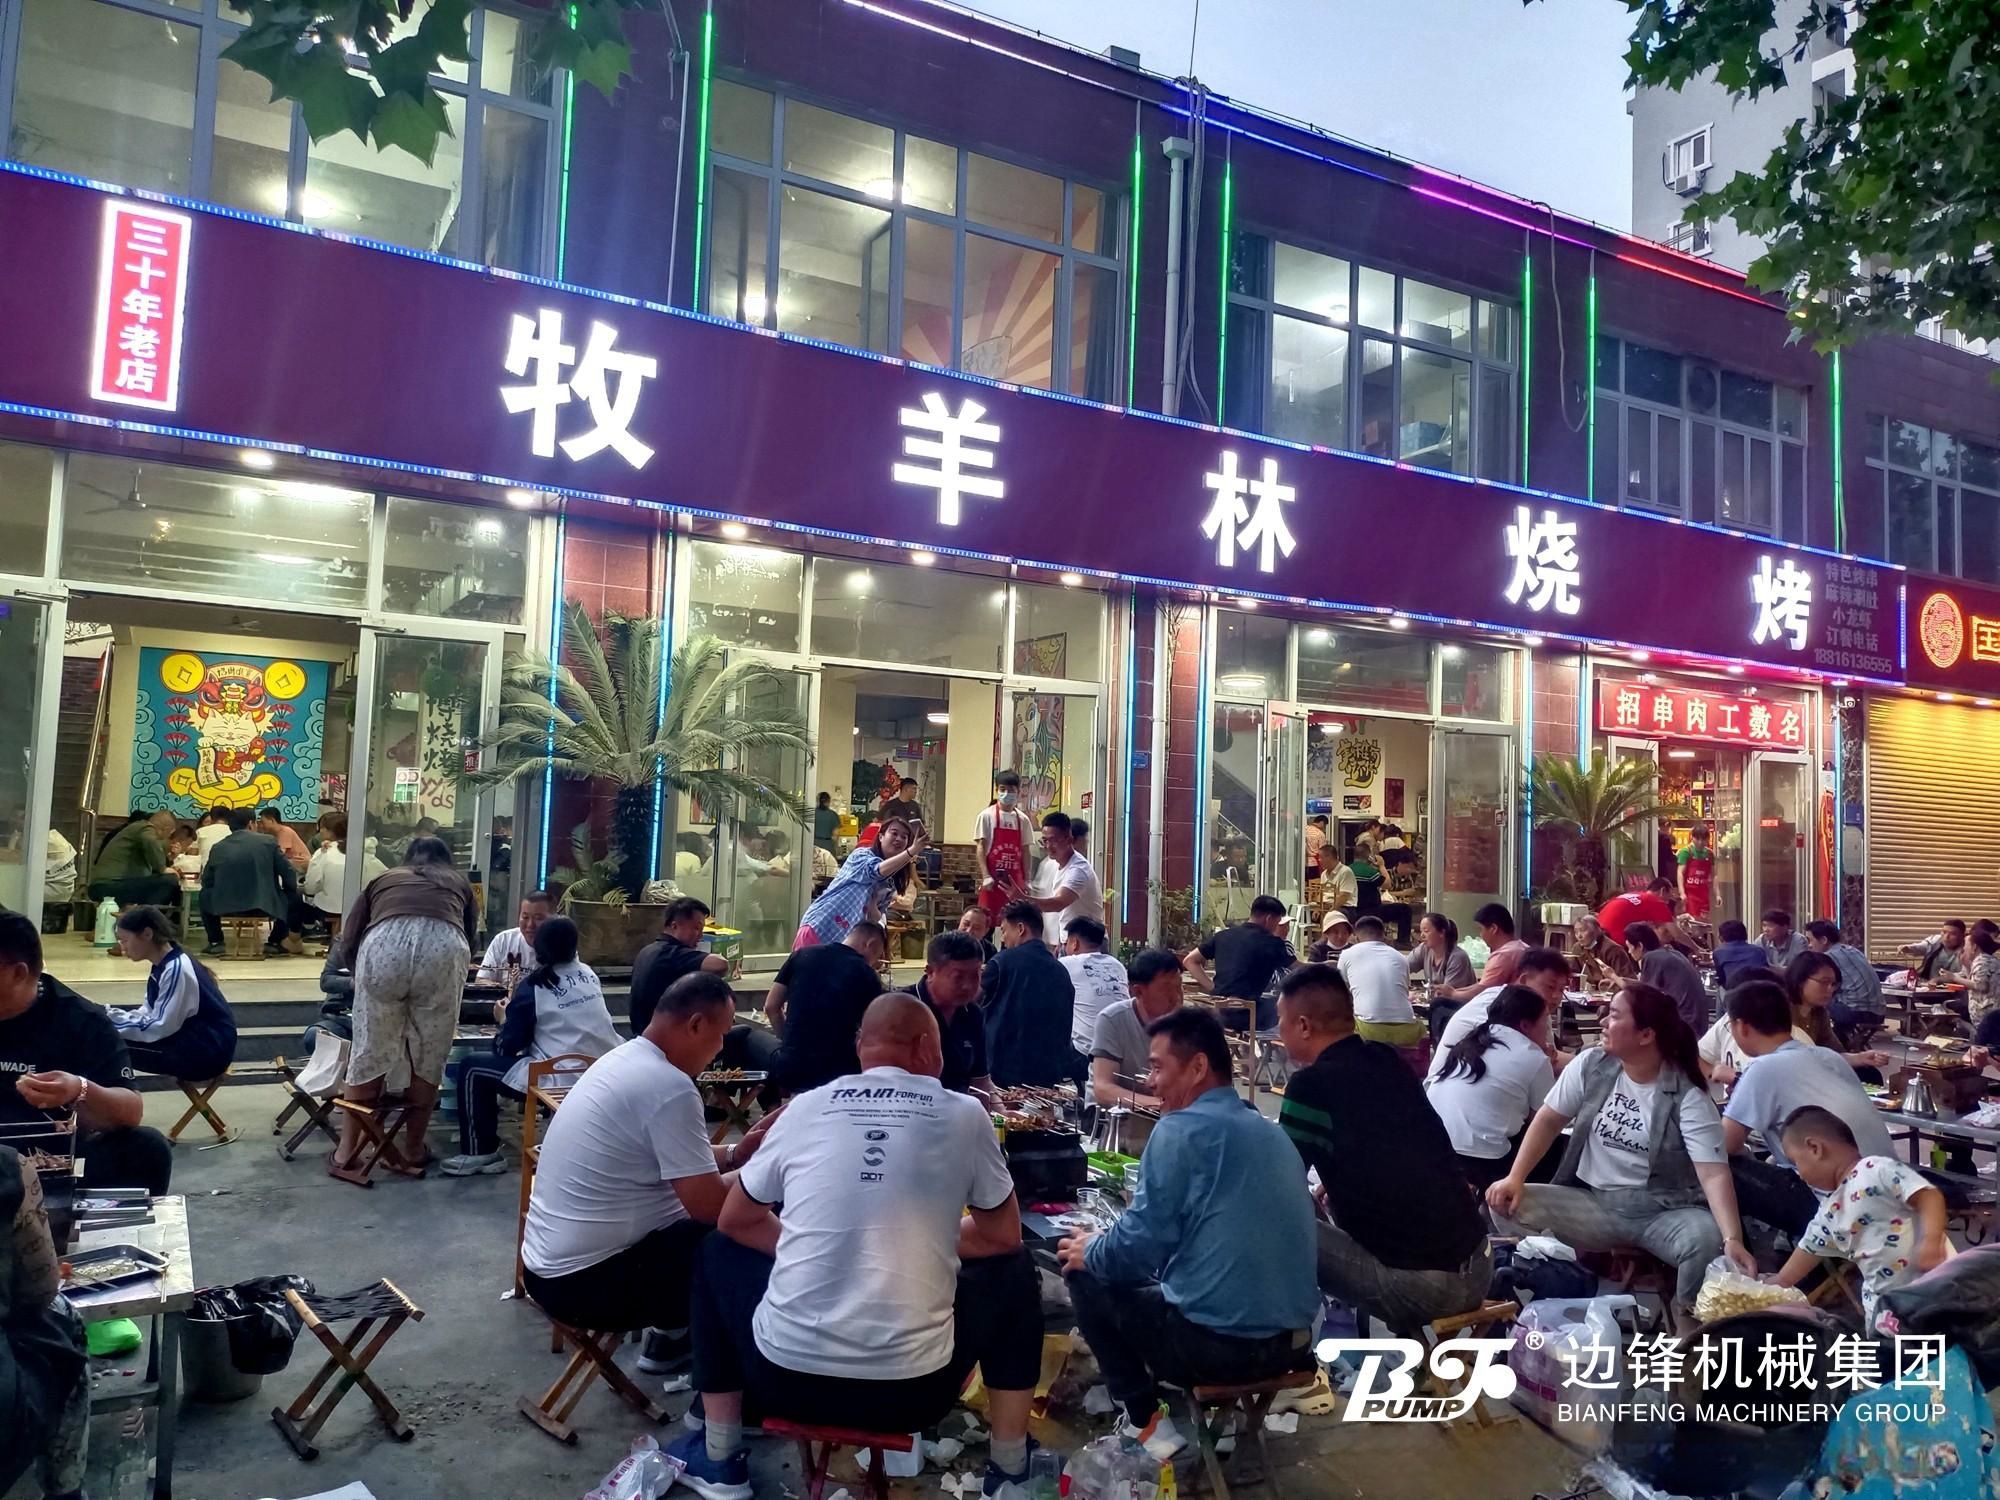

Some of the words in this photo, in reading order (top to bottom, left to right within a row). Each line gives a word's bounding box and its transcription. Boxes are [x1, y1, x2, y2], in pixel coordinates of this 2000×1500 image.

[116, 219, 169, 395] 三十年老店
[501, 307, 1812, 650] 牧羊林烧烤
[1825, 562, 1879, 587] 特色烤串
[1833, 606, 1873, 630] 小龙虾
[1826, 625, 1879, 653] 订餐电话
[1814, 648, 1892, 674] 18816136555
[0, 1061, 36, 1073] WADE
[831, 1088, 895, 1099] TRAIN
[1614, 1093, 1640, 1113] Fila
